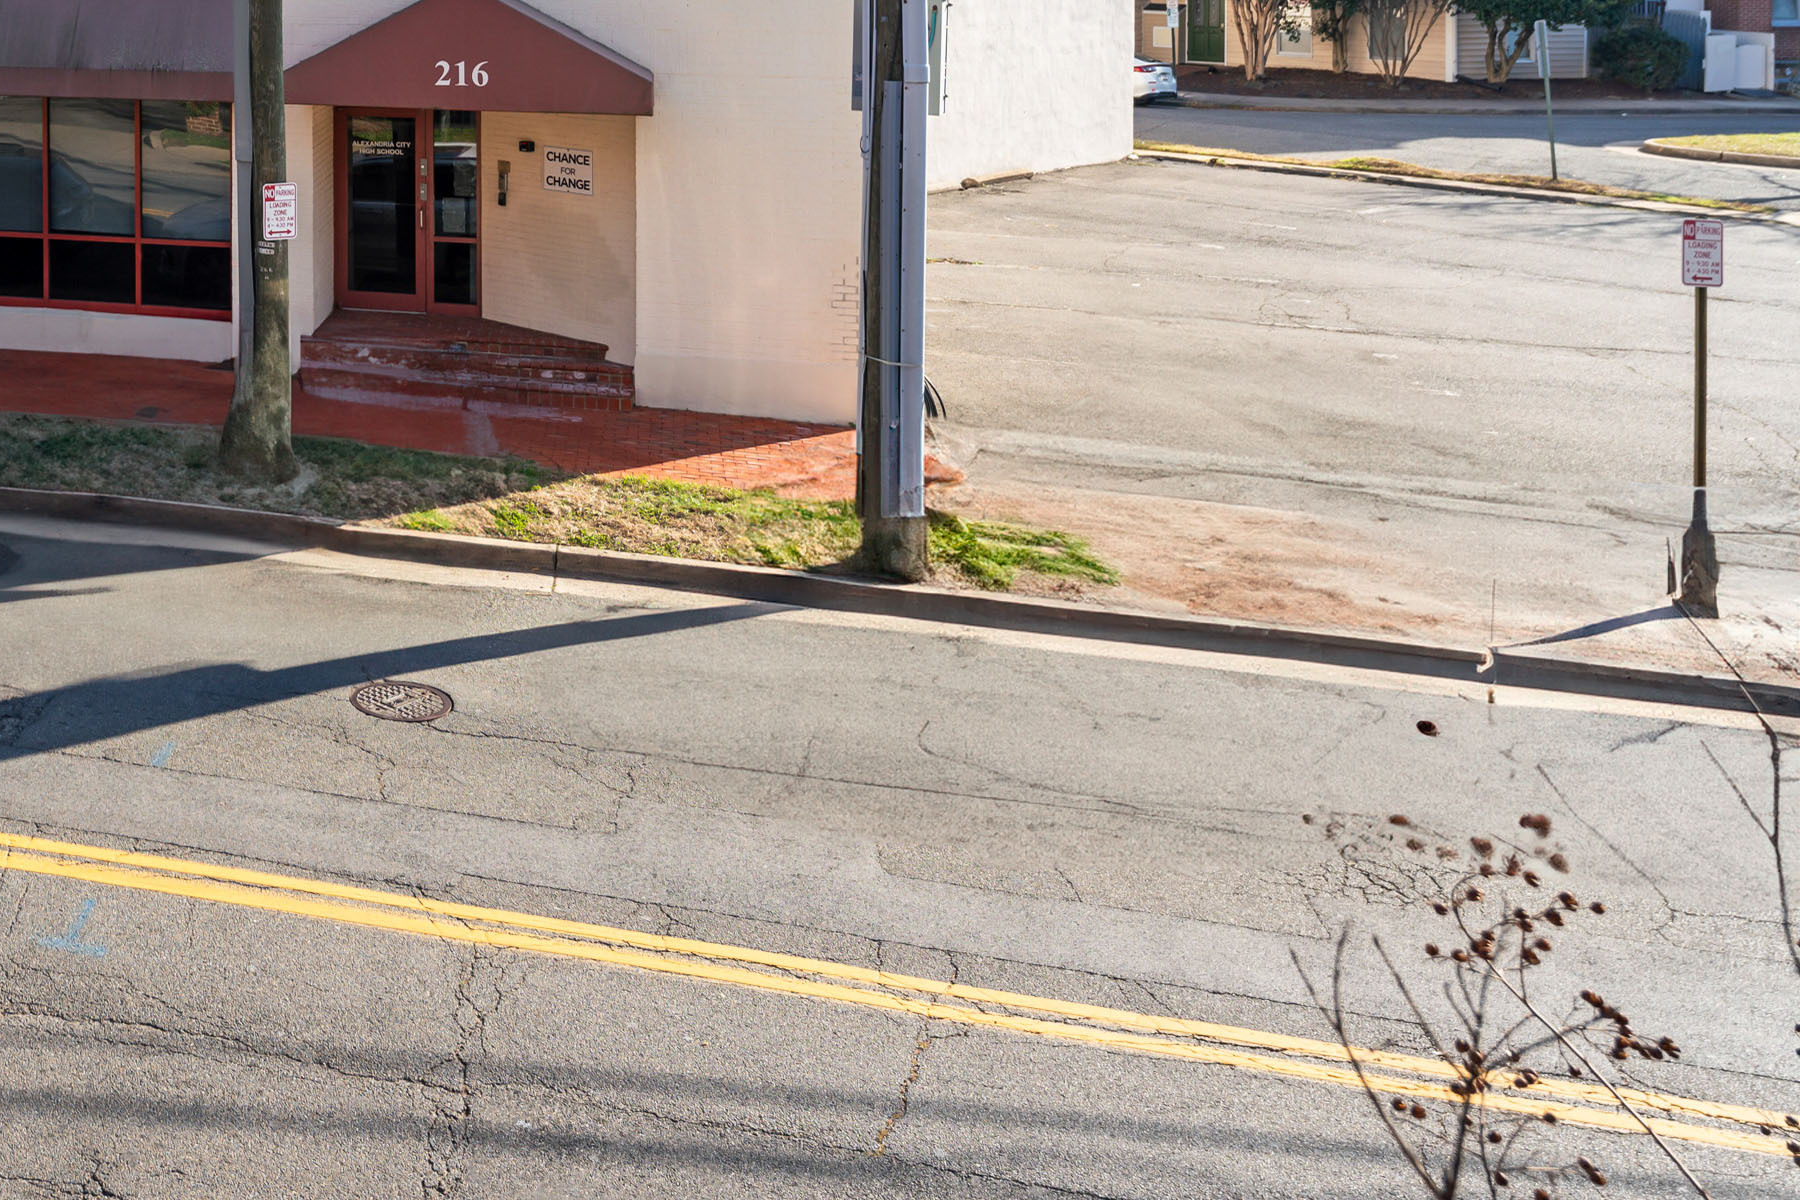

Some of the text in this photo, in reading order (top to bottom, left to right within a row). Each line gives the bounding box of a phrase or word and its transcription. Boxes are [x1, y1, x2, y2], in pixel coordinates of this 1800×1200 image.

[434, 60, 489, 87] 216
[352, 140, 394, 148] ALEXANDRIA
[546, 151, 590, 166] CHANCE
[560, 166, 576, 176] FOR
[546, 175, 591, 191] CHANGE
[264, 189, 275, 199] NO
[269, 201, 292, 209] LOADING
[1684, 223, 1720, 236] NO PARKING
[1688, 241, 1717, 249] LOADING
[1693, 251, 1712, 259] ZONE
